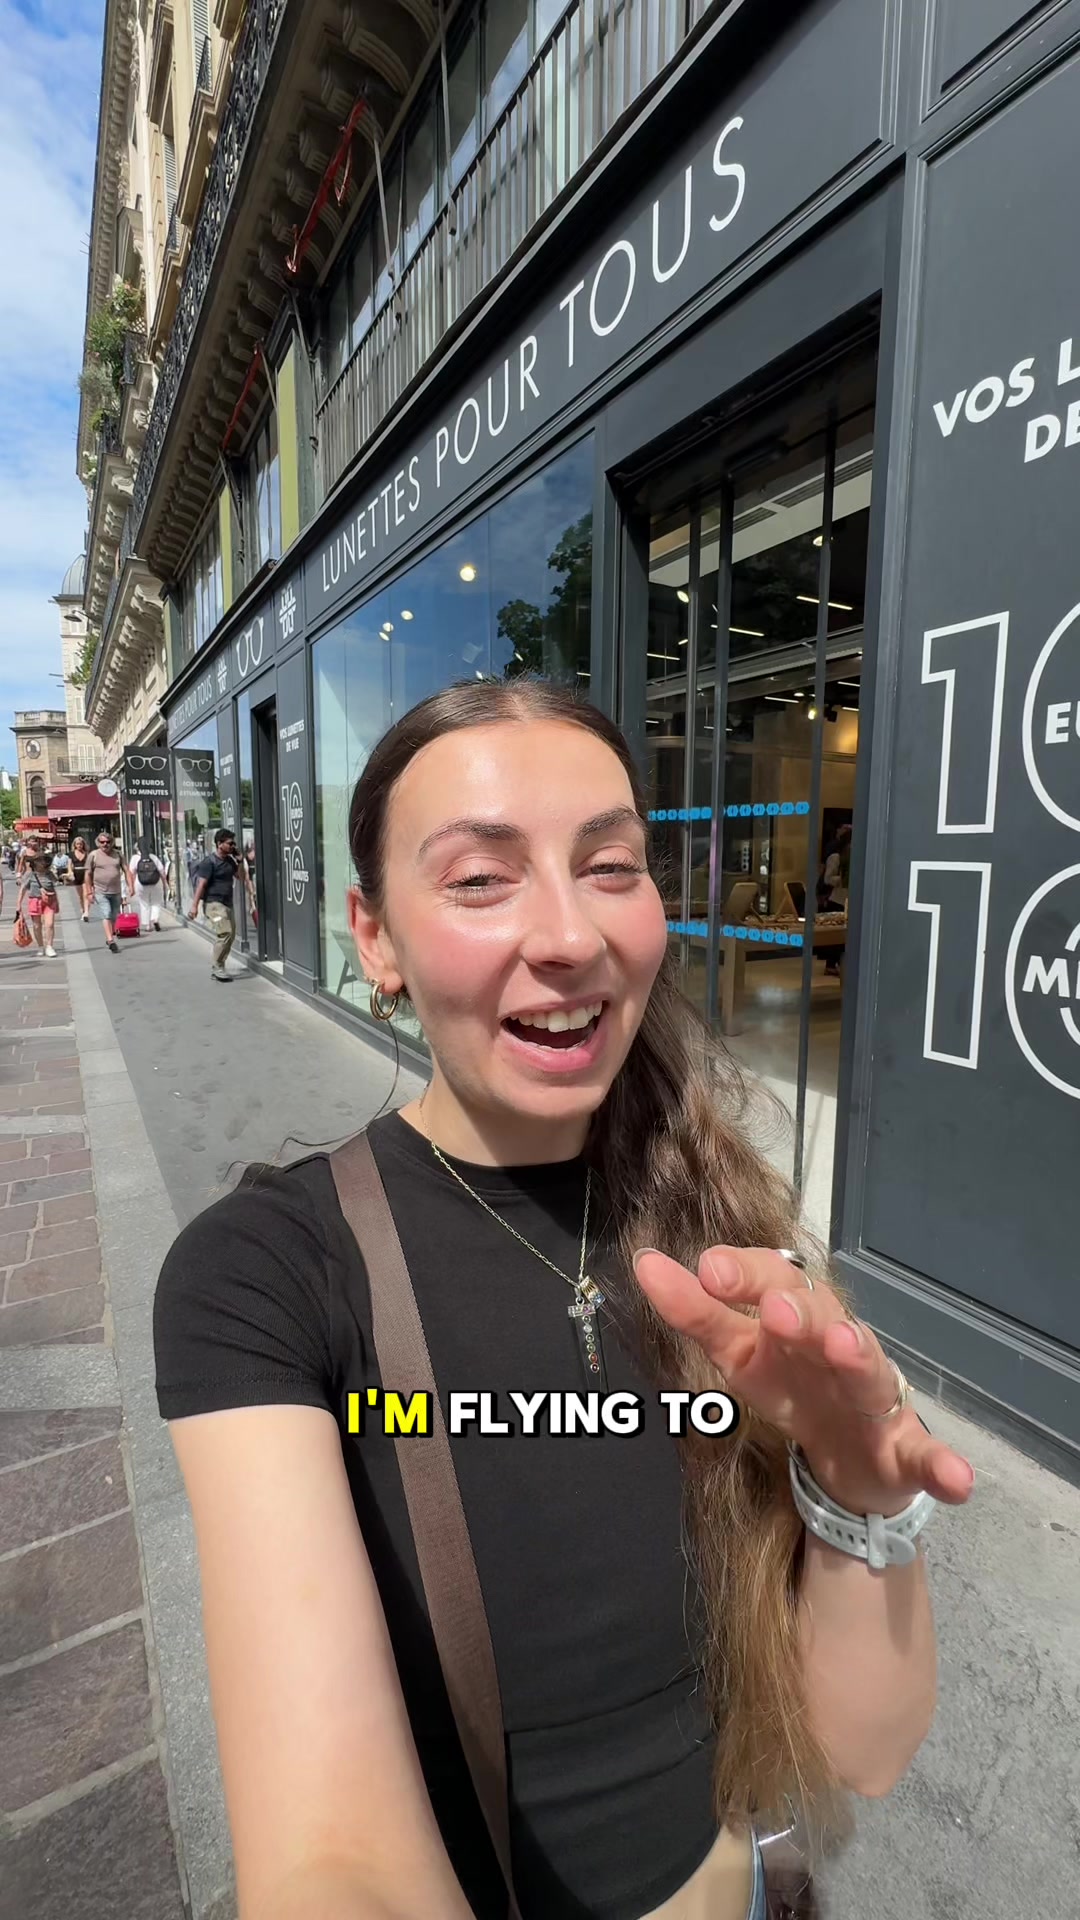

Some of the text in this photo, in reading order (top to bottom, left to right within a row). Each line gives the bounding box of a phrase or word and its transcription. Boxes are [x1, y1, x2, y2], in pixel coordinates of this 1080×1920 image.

[322, 116, 746, 592] LUNETTES POUR TOUS
[932, 357, 1035, 438] VOS
[1023, 399, 1080, 464] DE
[138, 788, 168, 796] MINUTES
[281, 782, 303, 842] 10
[284, 845, 305, 905] 10
